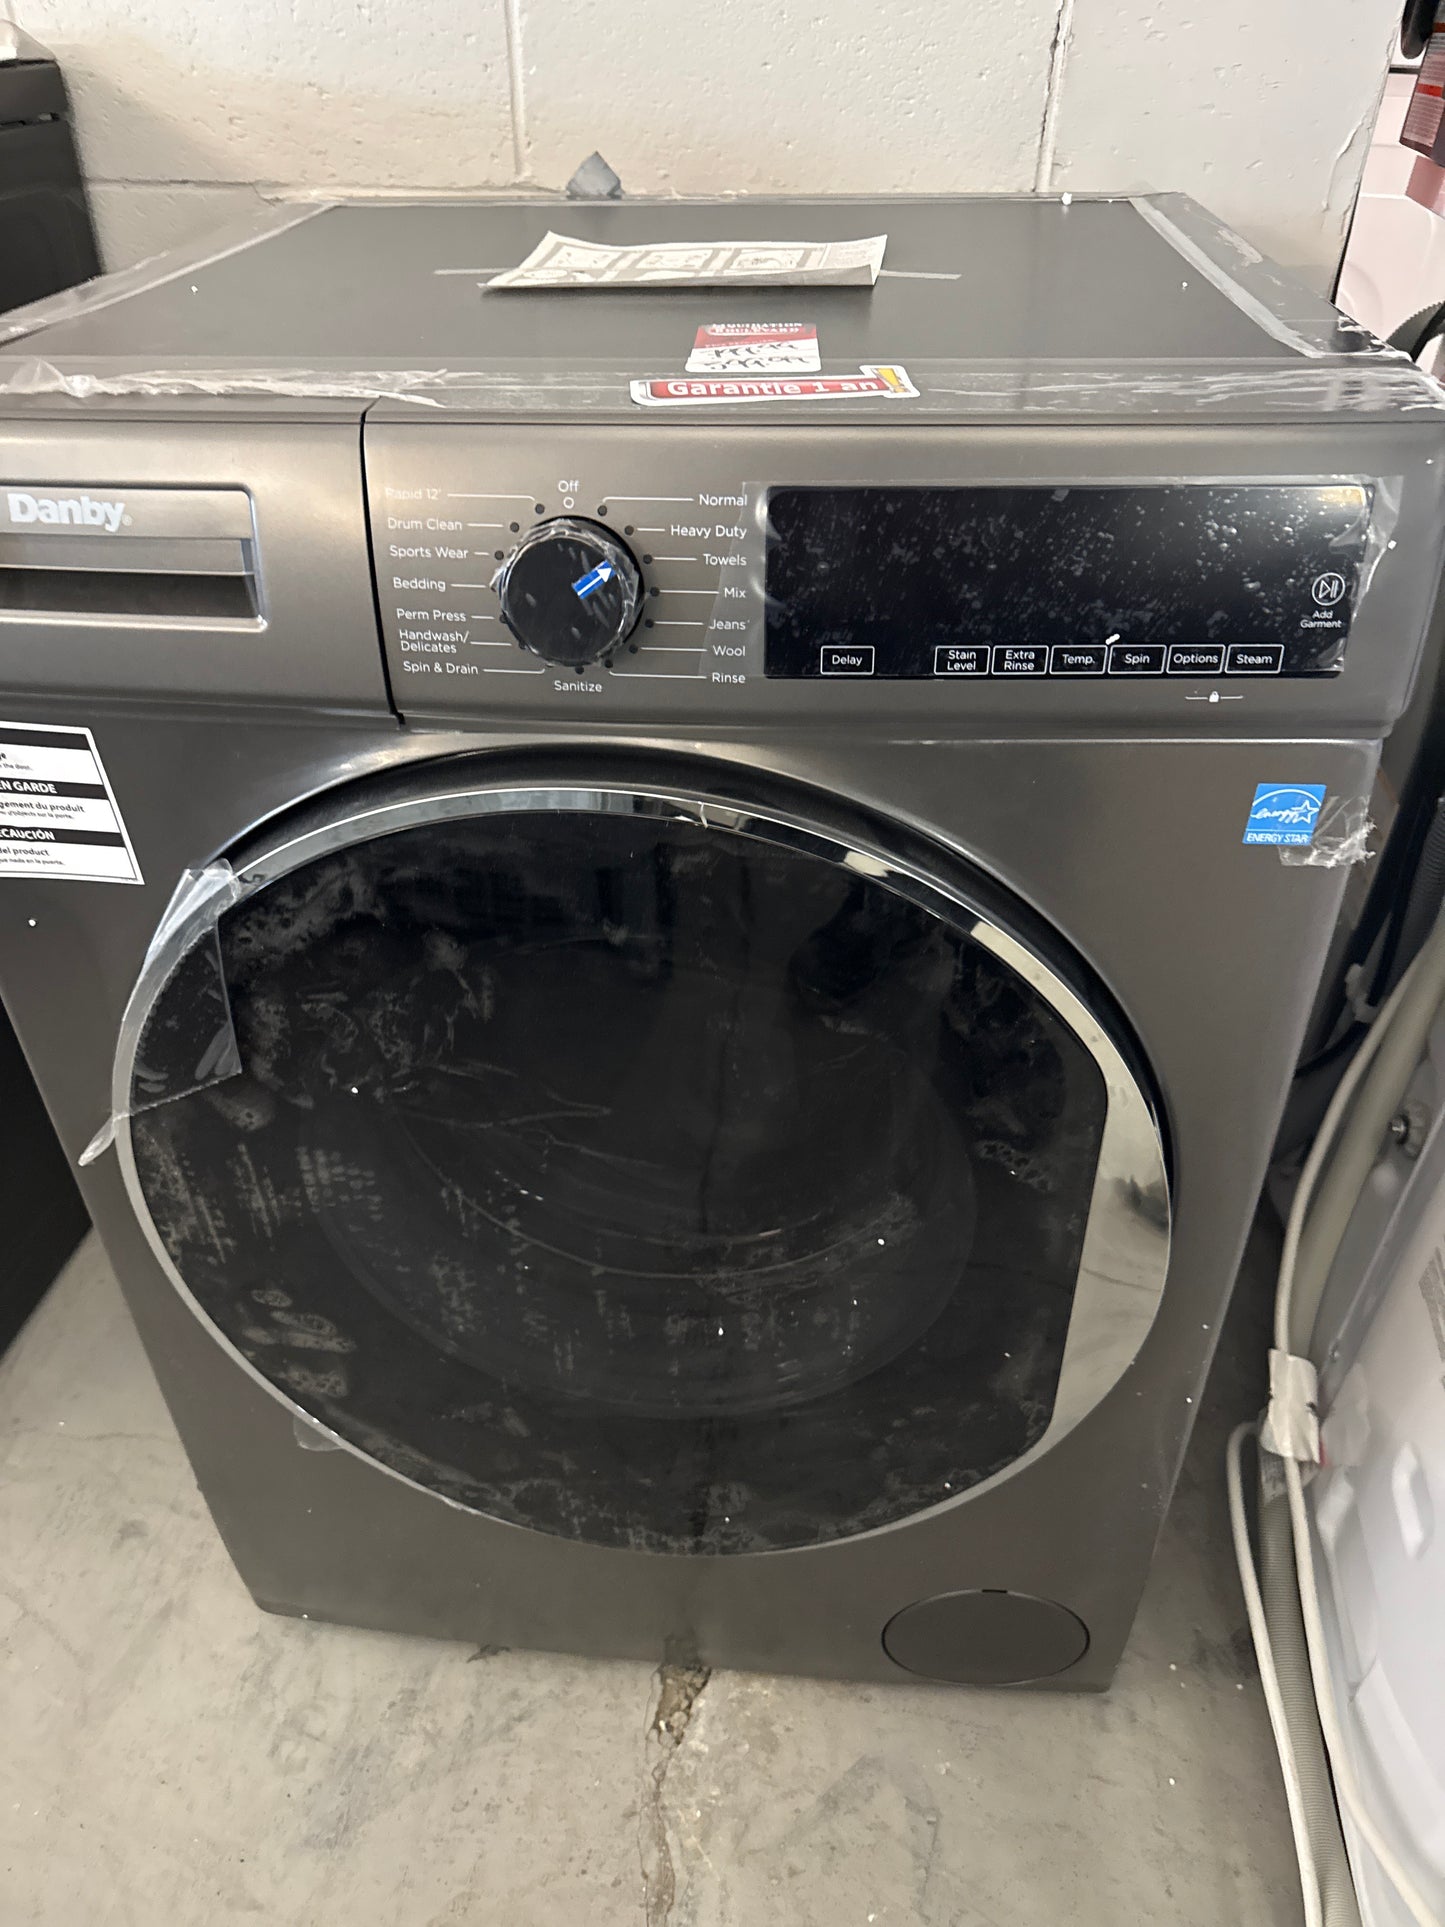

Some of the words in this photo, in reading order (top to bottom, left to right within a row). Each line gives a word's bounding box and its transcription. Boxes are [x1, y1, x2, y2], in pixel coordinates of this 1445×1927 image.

[668, 381, 799, 397] Garantie
[813, 378, 830, 393] 1
[841, 378, 879, 391] an
[558, 479, 580, 493] Off
[384, 488, 422, 501] Rapid
[699, 493, 748, 506] Normal
[7, 493, 126, 533] Danby
[387, 517, 423, 530] Drum
[426, 518, 463, 531] Clean
[670, 524, 712, 540] Heavy
[715, 525, 747, 540] Duty
[389, 545, 432, 559] Sports
[435, 547, 469, 559] Wear
[702, 553, 747, 566] Towels
[393, 576, 447, 592] Bedding
[724, 587, 746, 599] Mix
[396, 608, 430, 620] Perm
[433, 609, 467, 622] Press
[1312, 610, 1334, 619] Add
[709, 619, 746, 630] Jeans
[1300, 619, 1342, 628] Garment
[399, 629, 470, 643] Handwash/
[400, 641, 457, 654] Delicates
[712, 645, 746, 657] Wool
[831, 655, 863, 666] Delay
[948, 650, 977, 660] Stain
[1005, 650, 1035, 660] Extra
[1062, 654, 1096, 665] Temp.
[1124, 653, 1150, 665] Spin
[1173, 653, 1219, 664] Options
[1236, 654, 1273, 664] Steam
[403, 661, 431, 674] Spin
[434, 662, 443, 673] &
[446, 663, 479, 675] Drain
[947, 661, 976, 671] Level
[1004, 661, 1035, 671] Rinse
[711, 672, 746, 684] Rinse
[554, 680, 603, 693] Sanitize
[12, 781, 57, 793] GARDE
[35, 802, 48, 810] du
[49, 803, 86, 813] produit
[1246, 832, 1283, 843] ENERGY
[1283, 833, 1308, 844] STAR
[12, 848, 51, 857] product
